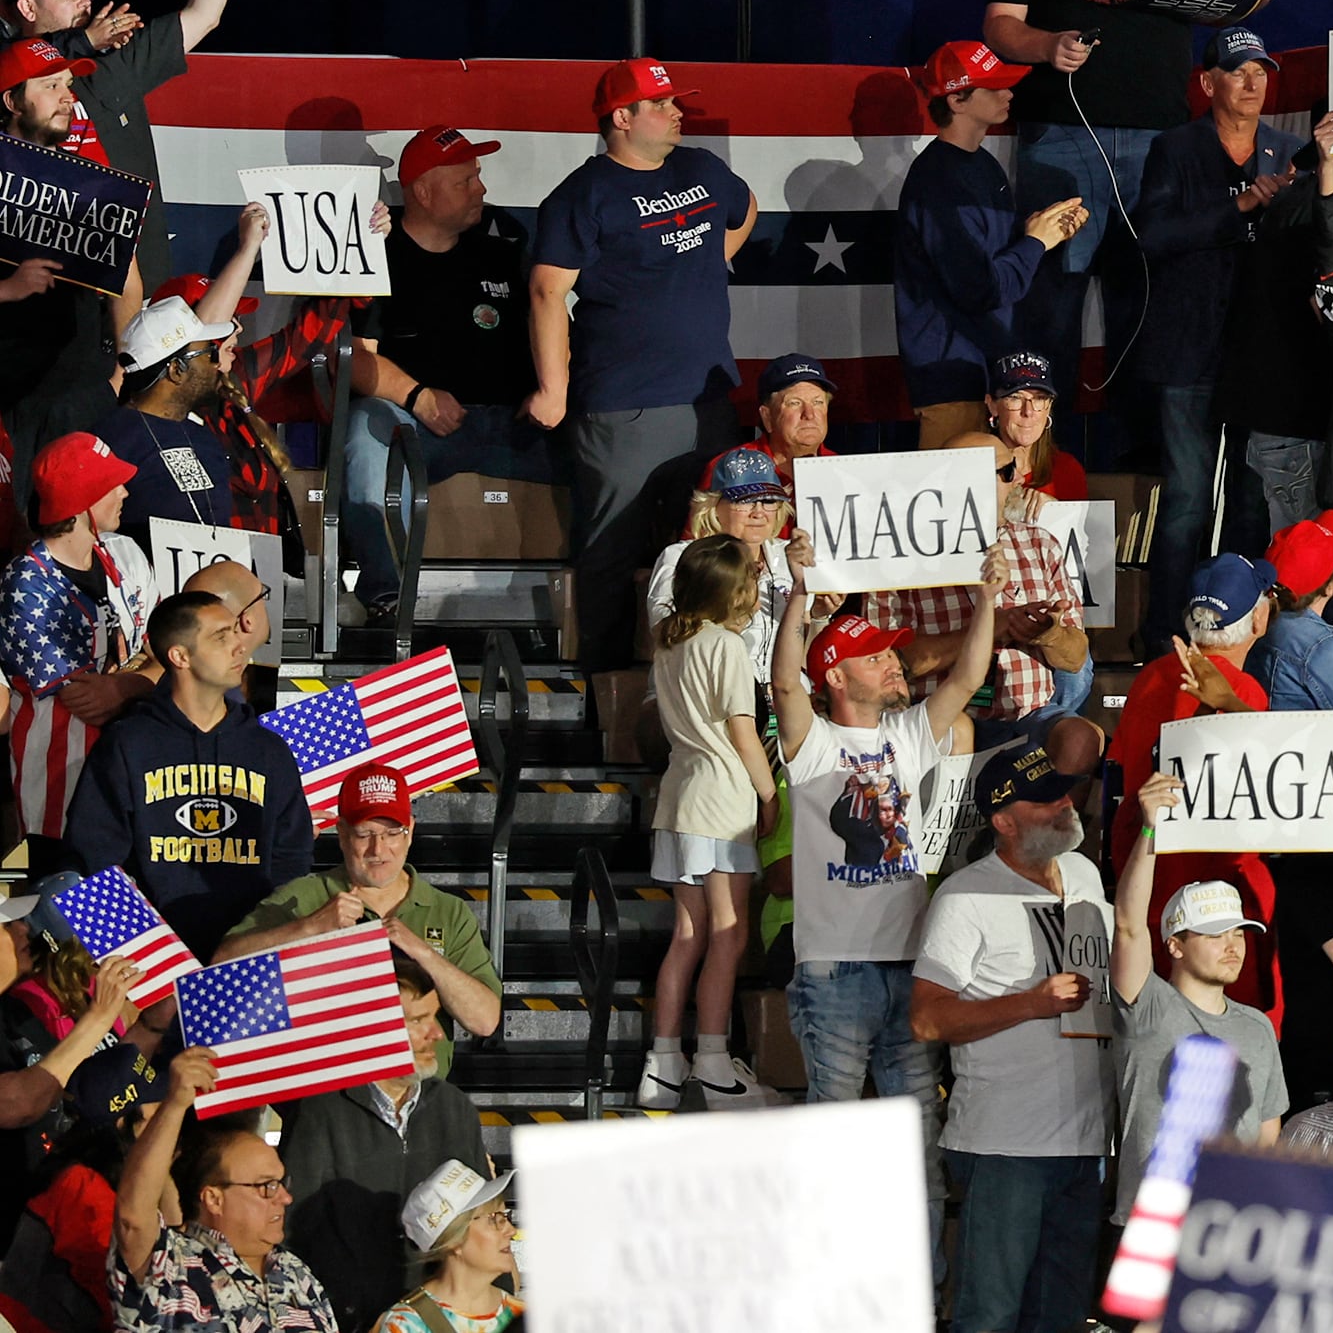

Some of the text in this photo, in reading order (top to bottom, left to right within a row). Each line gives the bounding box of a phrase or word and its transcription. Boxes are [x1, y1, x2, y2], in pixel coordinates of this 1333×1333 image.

[0, 171, 138, 239] LDEN AGE
[632, 185, 709, 217] Benham
[264, 190, 376, 276] USA
[674, 236, 704, 254] 2026
[676, 221, 712, 244] Senate
[807, 486, 990, 562] MAGA
[823, 645, 838, 664] 47
[144, 764, 266, 807] MICHIGAN
[359, 777, 396, 787] DONALD
[359, 785, 397, 794] TRUMP
[194, 809, 220, 830] M
[150, 836, 260, 864] FOOTBALL
[109, 1084, 139, 1112] 45-47
